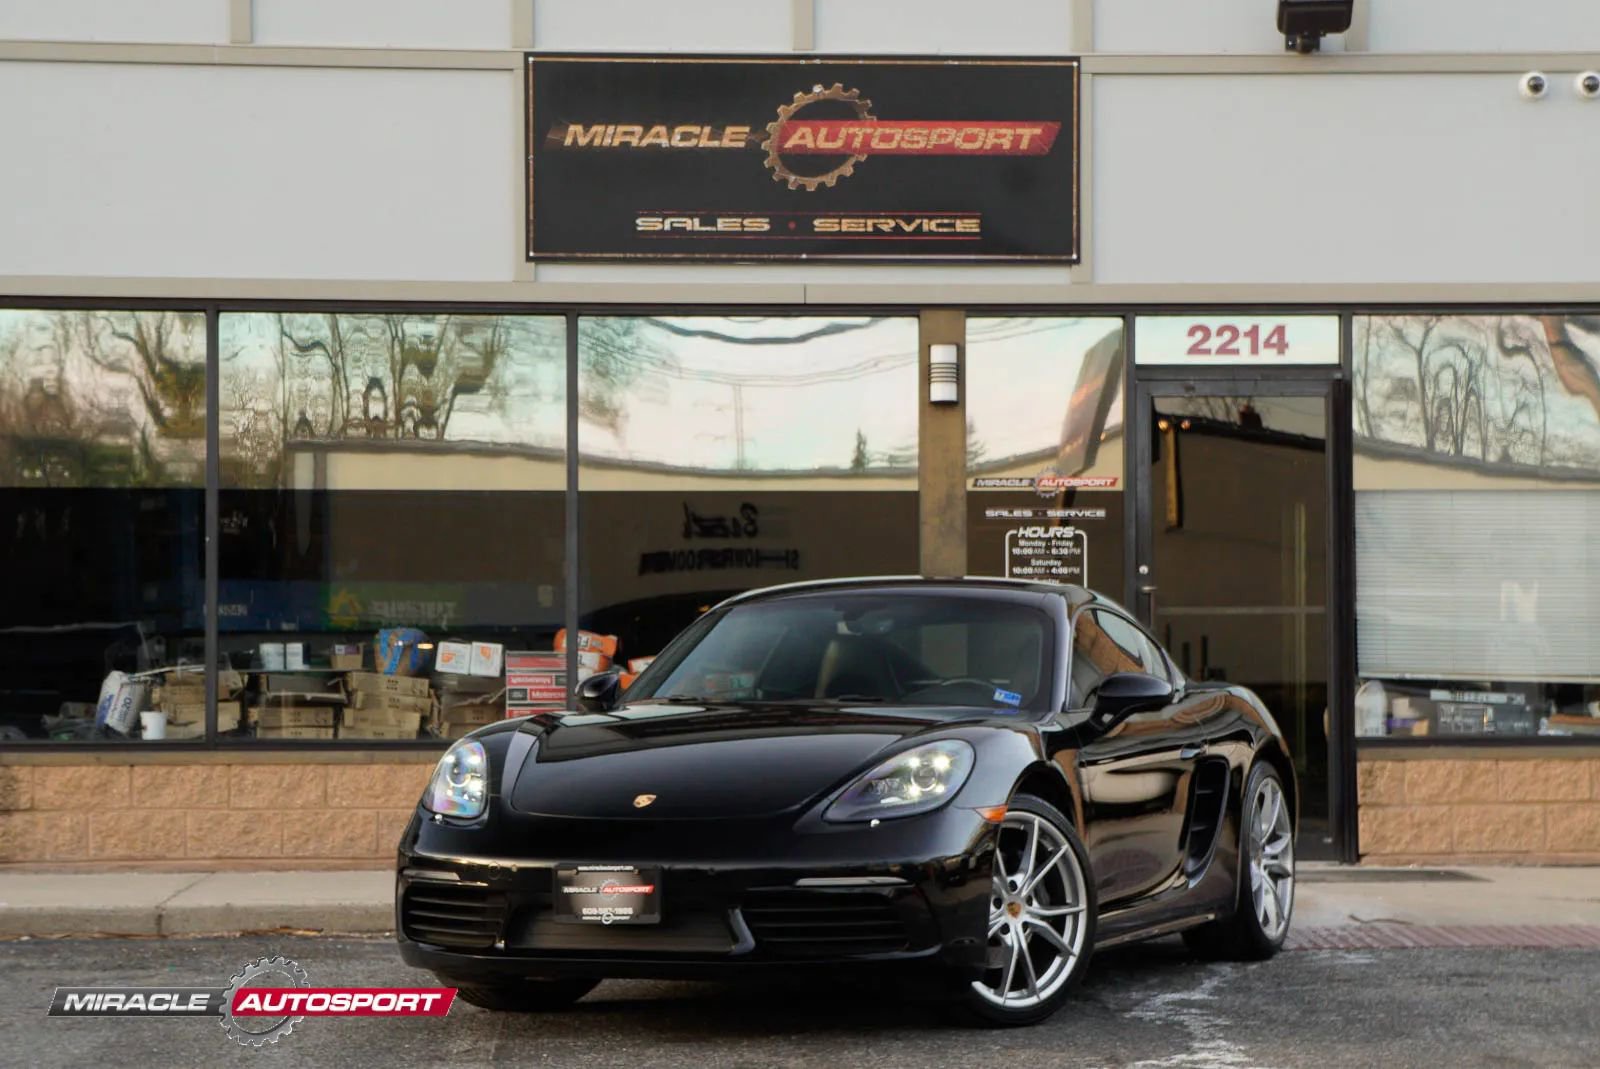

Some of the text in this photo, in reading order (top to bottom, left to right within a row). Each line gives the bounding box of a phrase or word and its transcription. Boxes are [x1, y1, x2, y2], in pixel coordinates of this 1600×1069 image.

[563, 124, 1043, 150] MIRACLE AUTOSPORT
[635, 216, 982, 233] SALES SERVICE
[1186, 323, 1290, 356] 2214
[976, 478, 1114, 487] MIRACLE AUTOSPORT
[985, 509, 1106, 518] SALES SERVICE
[1017, 526, 1075, 538] HOURS
[1051, 539, 1074, 548] Friday
[1030, 558, 1062, 567] Saturday
